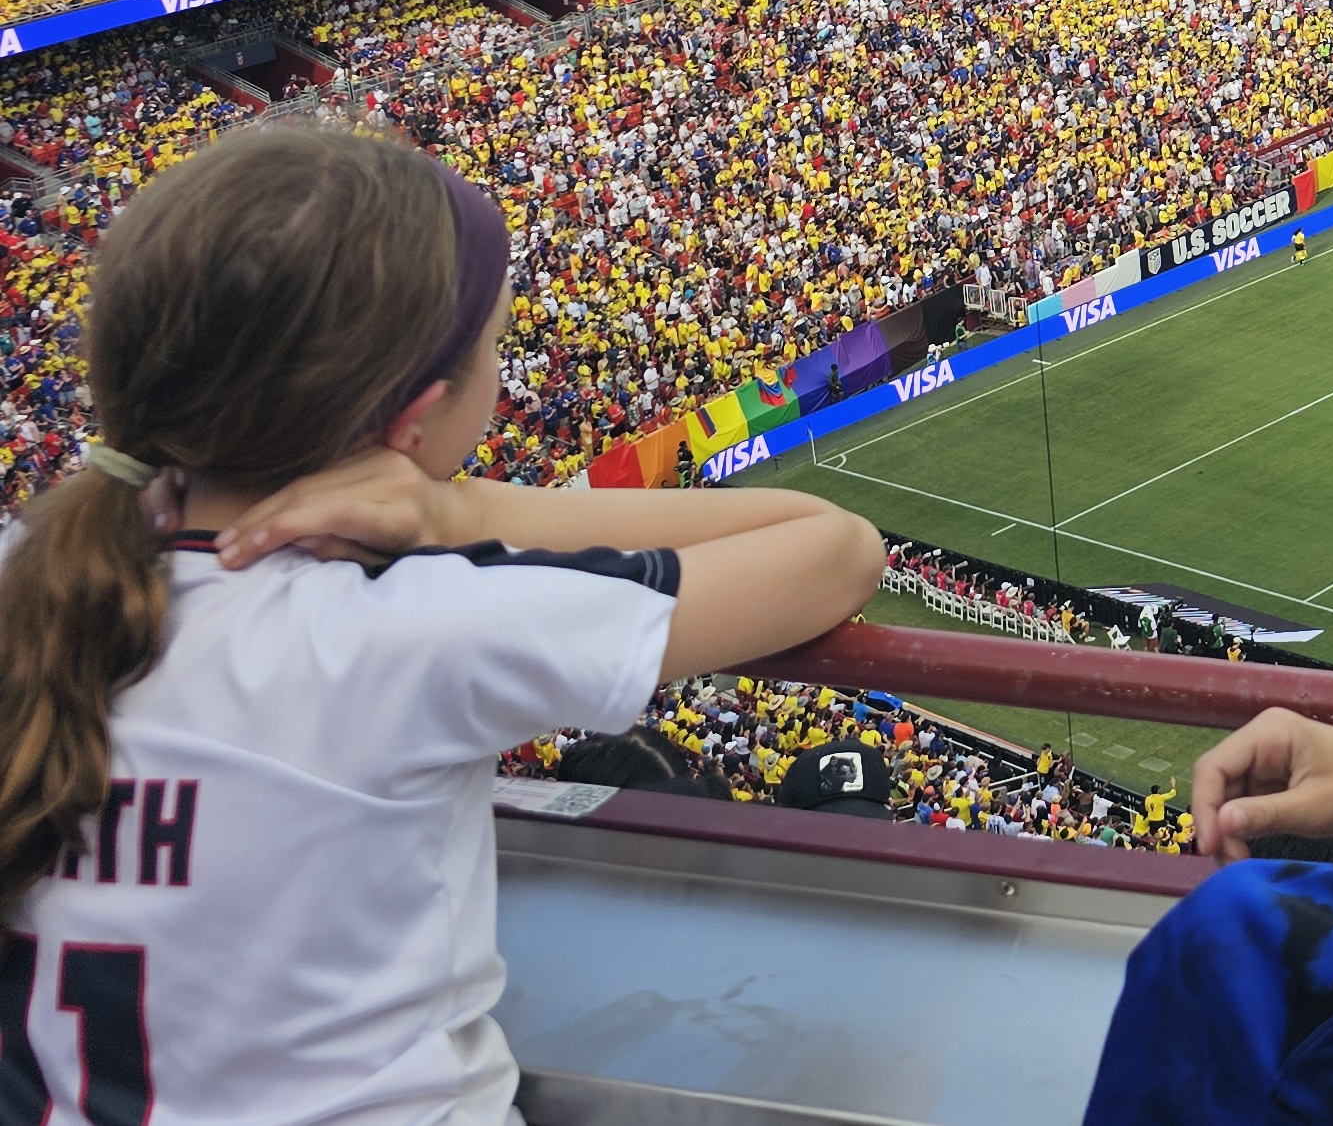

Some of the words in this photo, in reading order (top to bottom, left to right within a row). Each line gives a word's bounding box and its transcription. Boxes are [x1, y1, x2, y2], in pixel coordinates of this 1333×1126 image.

[1171, 224, 1210, 266] U.S.
[1213, 190, 1291, 246] SOCCER
[1208, 237, 1261, 273] VISA
[1059, 294, 1117, 333] VISA
[889, 360, 955, 402] VISA
[705, 434, 771, 482] VISA
